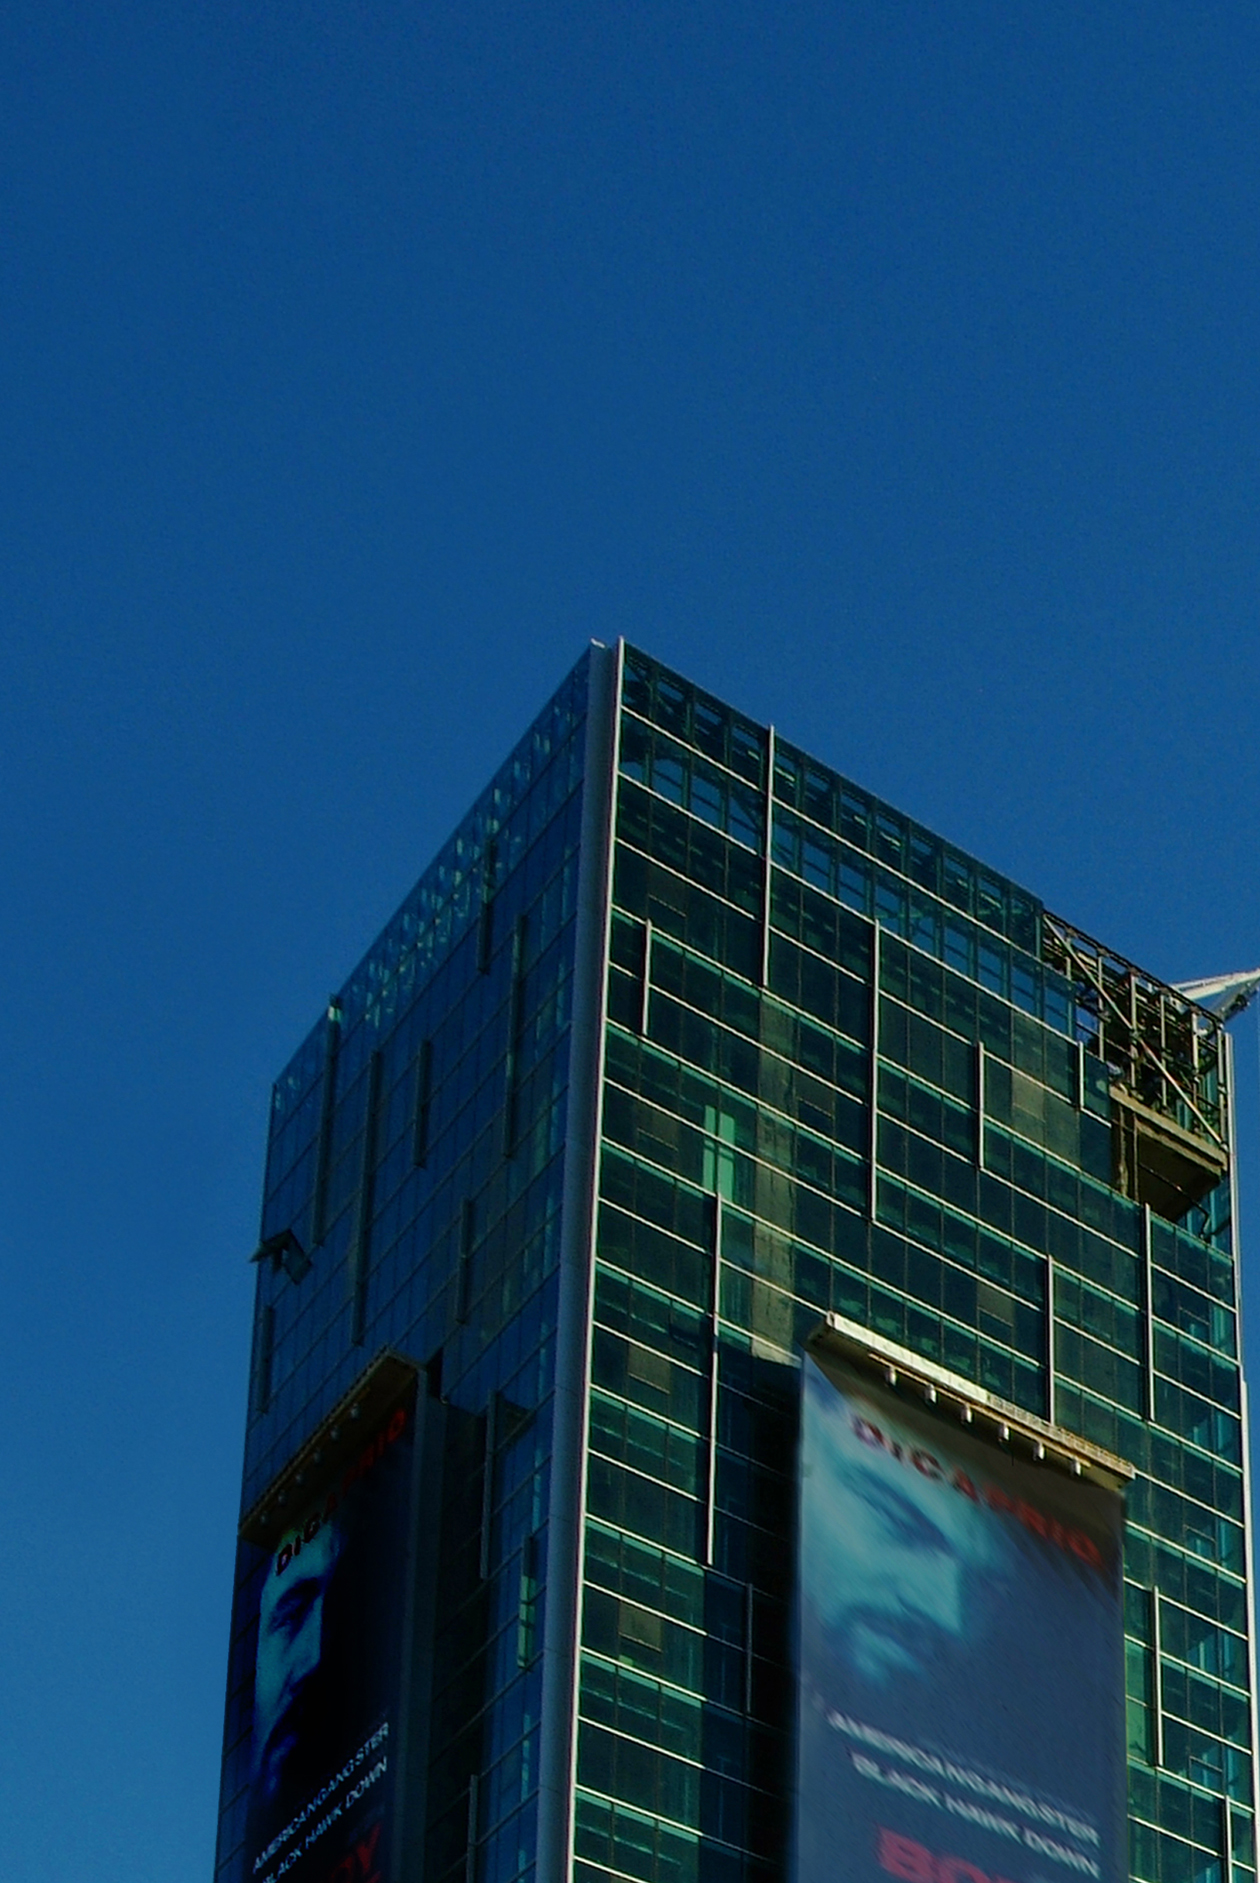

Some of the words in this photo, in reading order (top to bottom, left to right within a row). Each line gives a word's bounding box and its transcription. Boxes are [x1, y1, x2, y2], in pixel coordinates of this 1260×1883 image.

[253, 1797, 317, 1875] AMERICAN
[318, 1721, 390, 1806] GANGSTER
[304, 1801, 343, 1849] HAWK
[345, 1755, 388, 1810] DOWN
